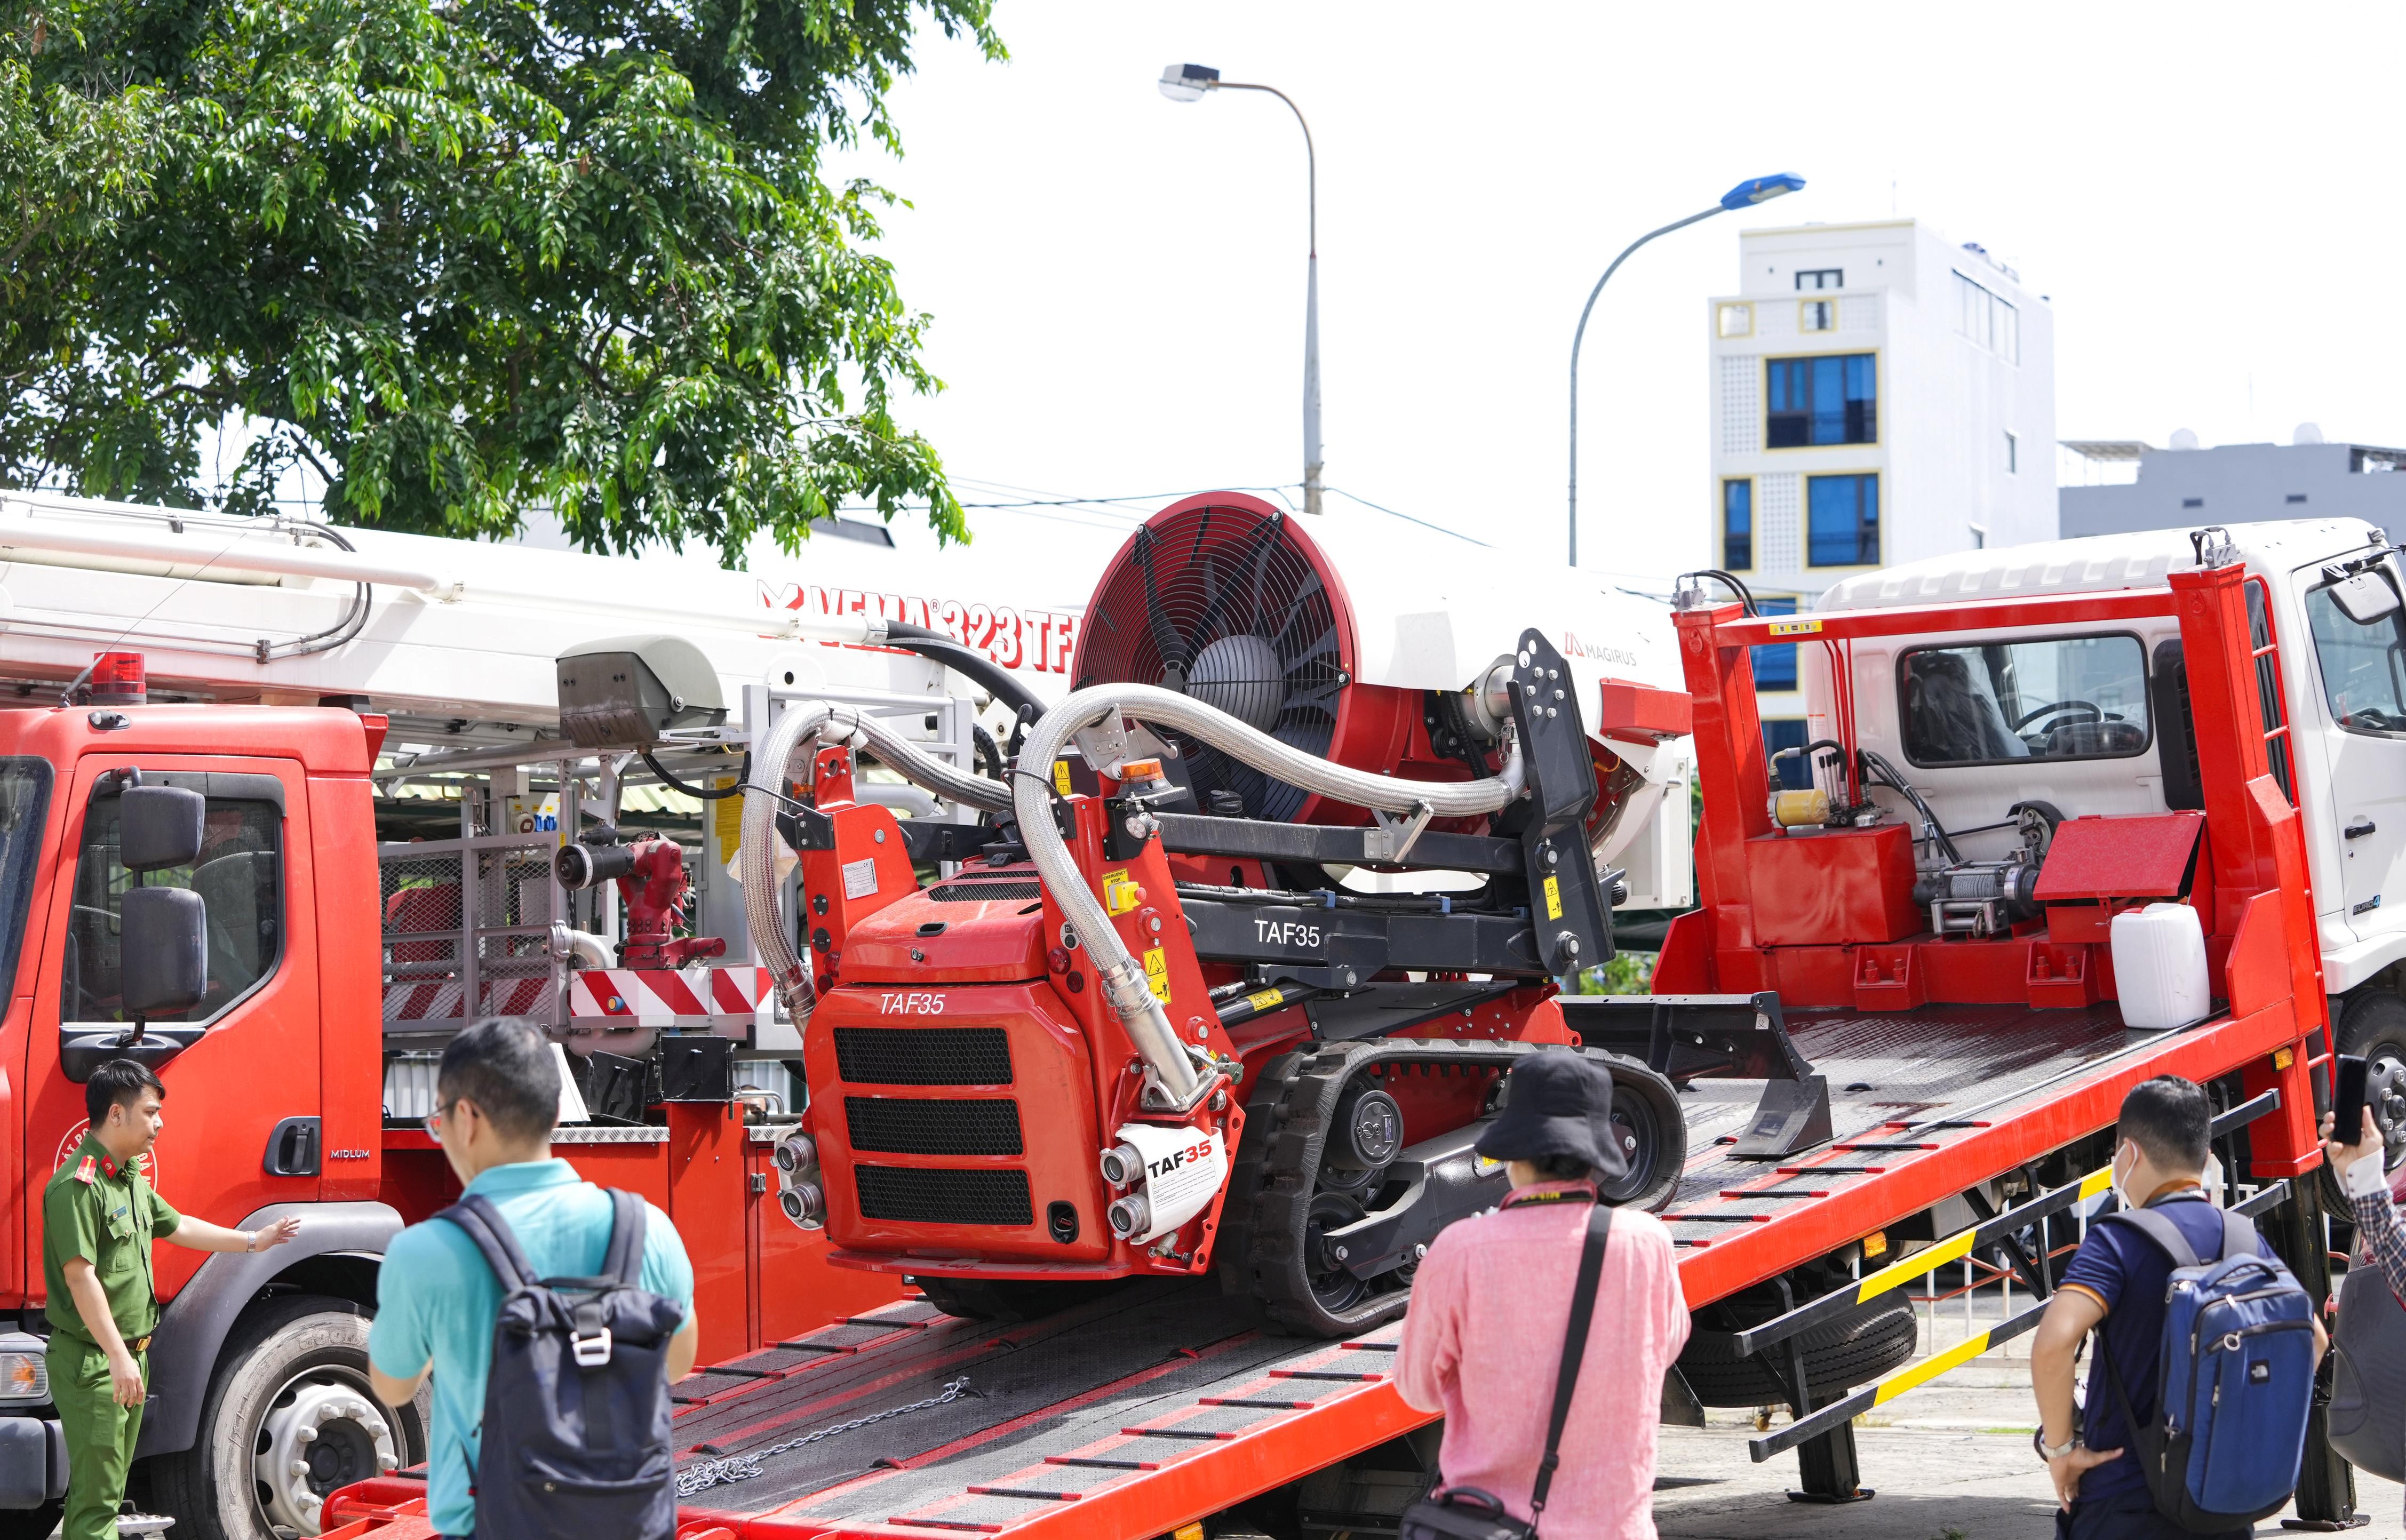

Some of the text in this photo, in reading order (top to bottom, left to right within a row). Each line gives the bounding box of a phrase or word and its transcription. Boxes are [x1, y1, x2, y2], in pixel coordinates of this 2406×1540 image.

[942, 600, 1022, 669] 323
[1585, 644, 1637, 666] MAGIRUS
[1103, 870, 1126, 880] EMERGENCY
[2354, 895, 2380, 913] EURO4
[1254, 920, 1320, 947] TAF35
[881, 993, 946, 1015] TAF35
[331, 1150, 370, 1158] MIDLUM
[1148, 1139, 1212, 1178] TAF35
